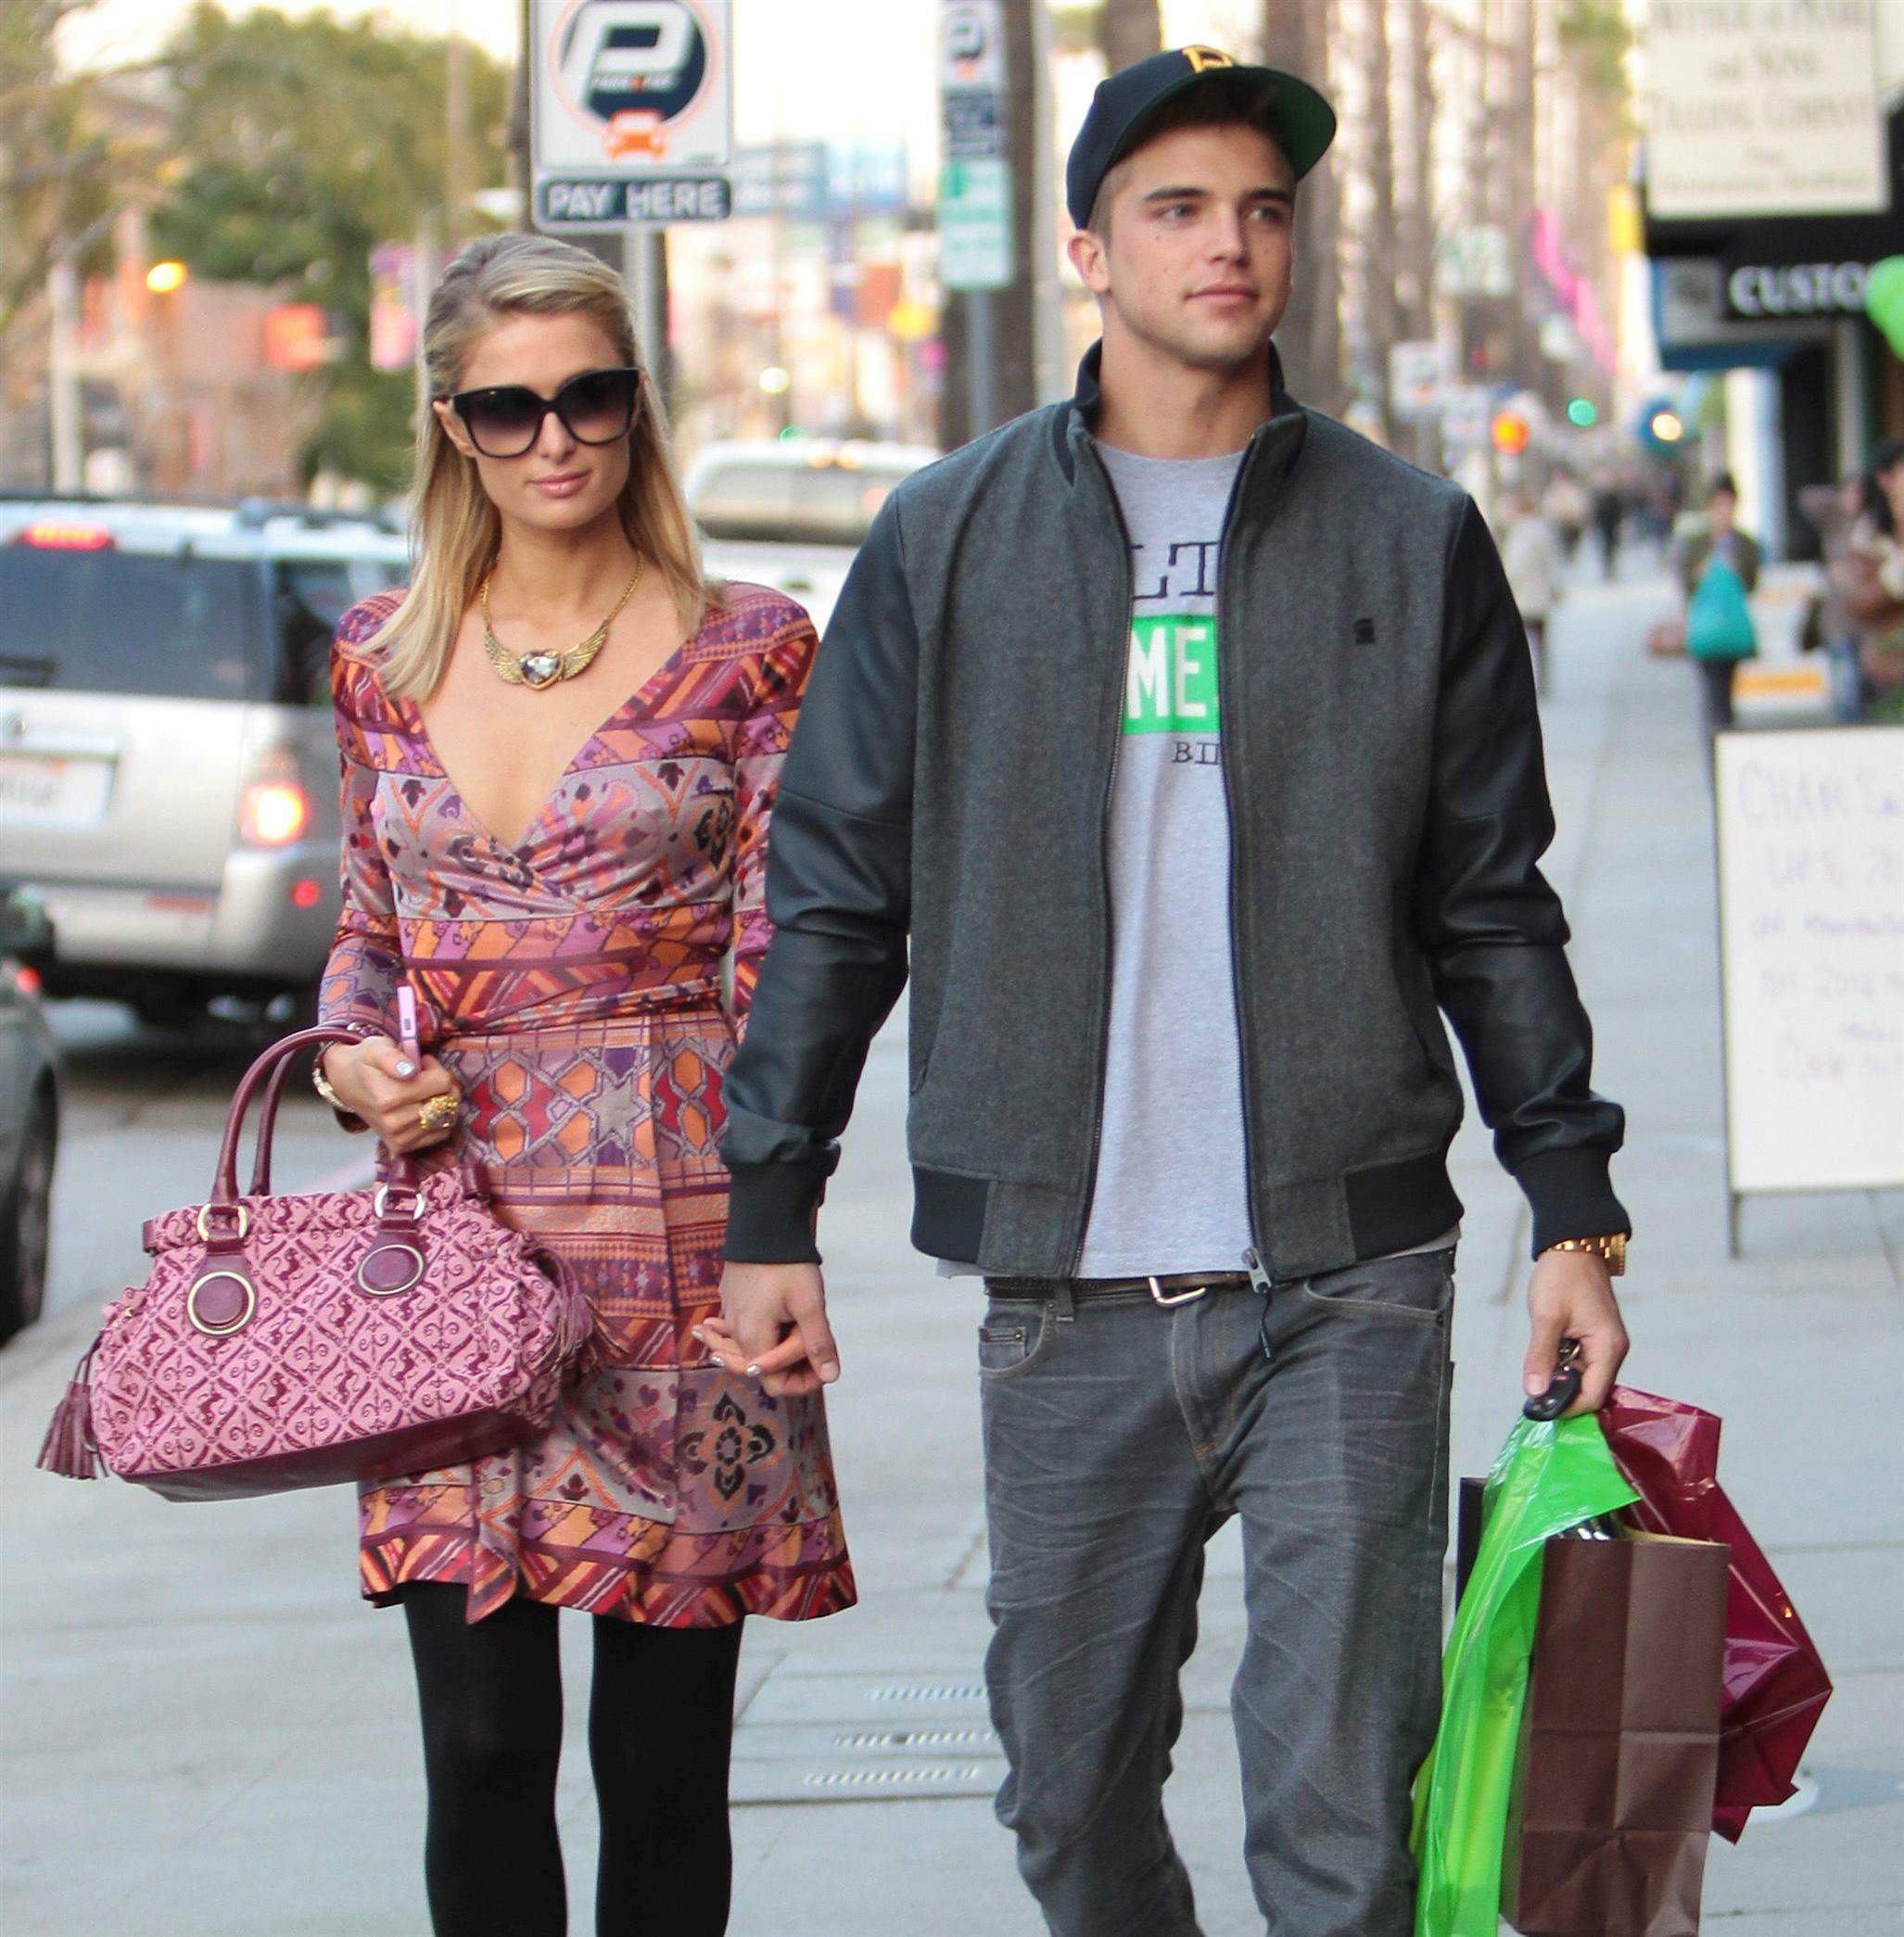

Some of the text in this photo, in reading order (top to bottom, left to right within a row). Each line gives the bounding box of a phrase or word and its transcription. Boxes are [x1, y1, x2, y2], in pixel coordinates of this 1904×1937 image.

[561, 0, 693, 110] P
[548, 183, 614, 220] PAY
[626, 181, 723, 220] HERE
